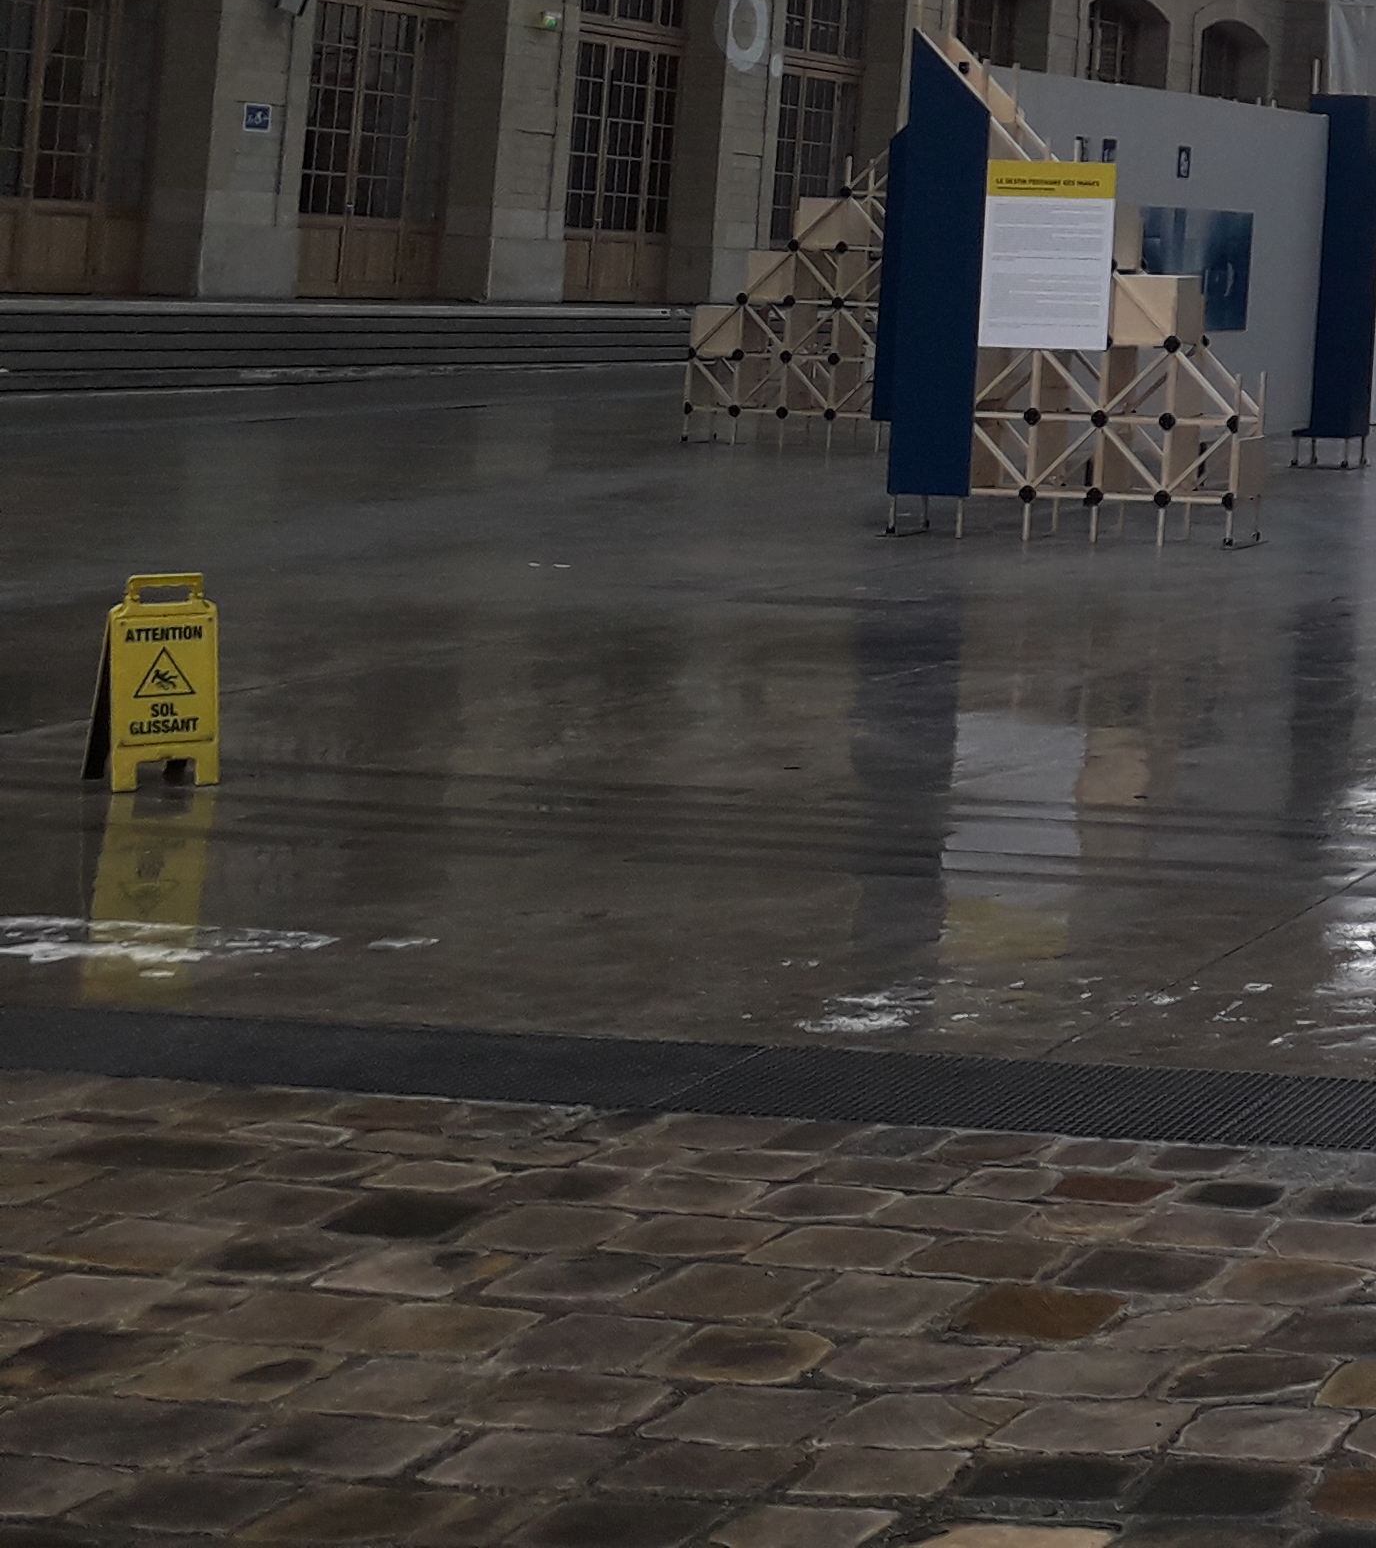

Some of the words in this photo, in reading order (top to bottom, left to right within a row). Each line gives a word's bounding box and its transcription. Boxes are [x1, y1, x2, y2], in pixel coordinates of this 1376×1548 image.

[125, 625, 203, 642] ATTENTION
[150, 703, 178, 718] SOL
[129, 717, 200, 736] GLISSANT
